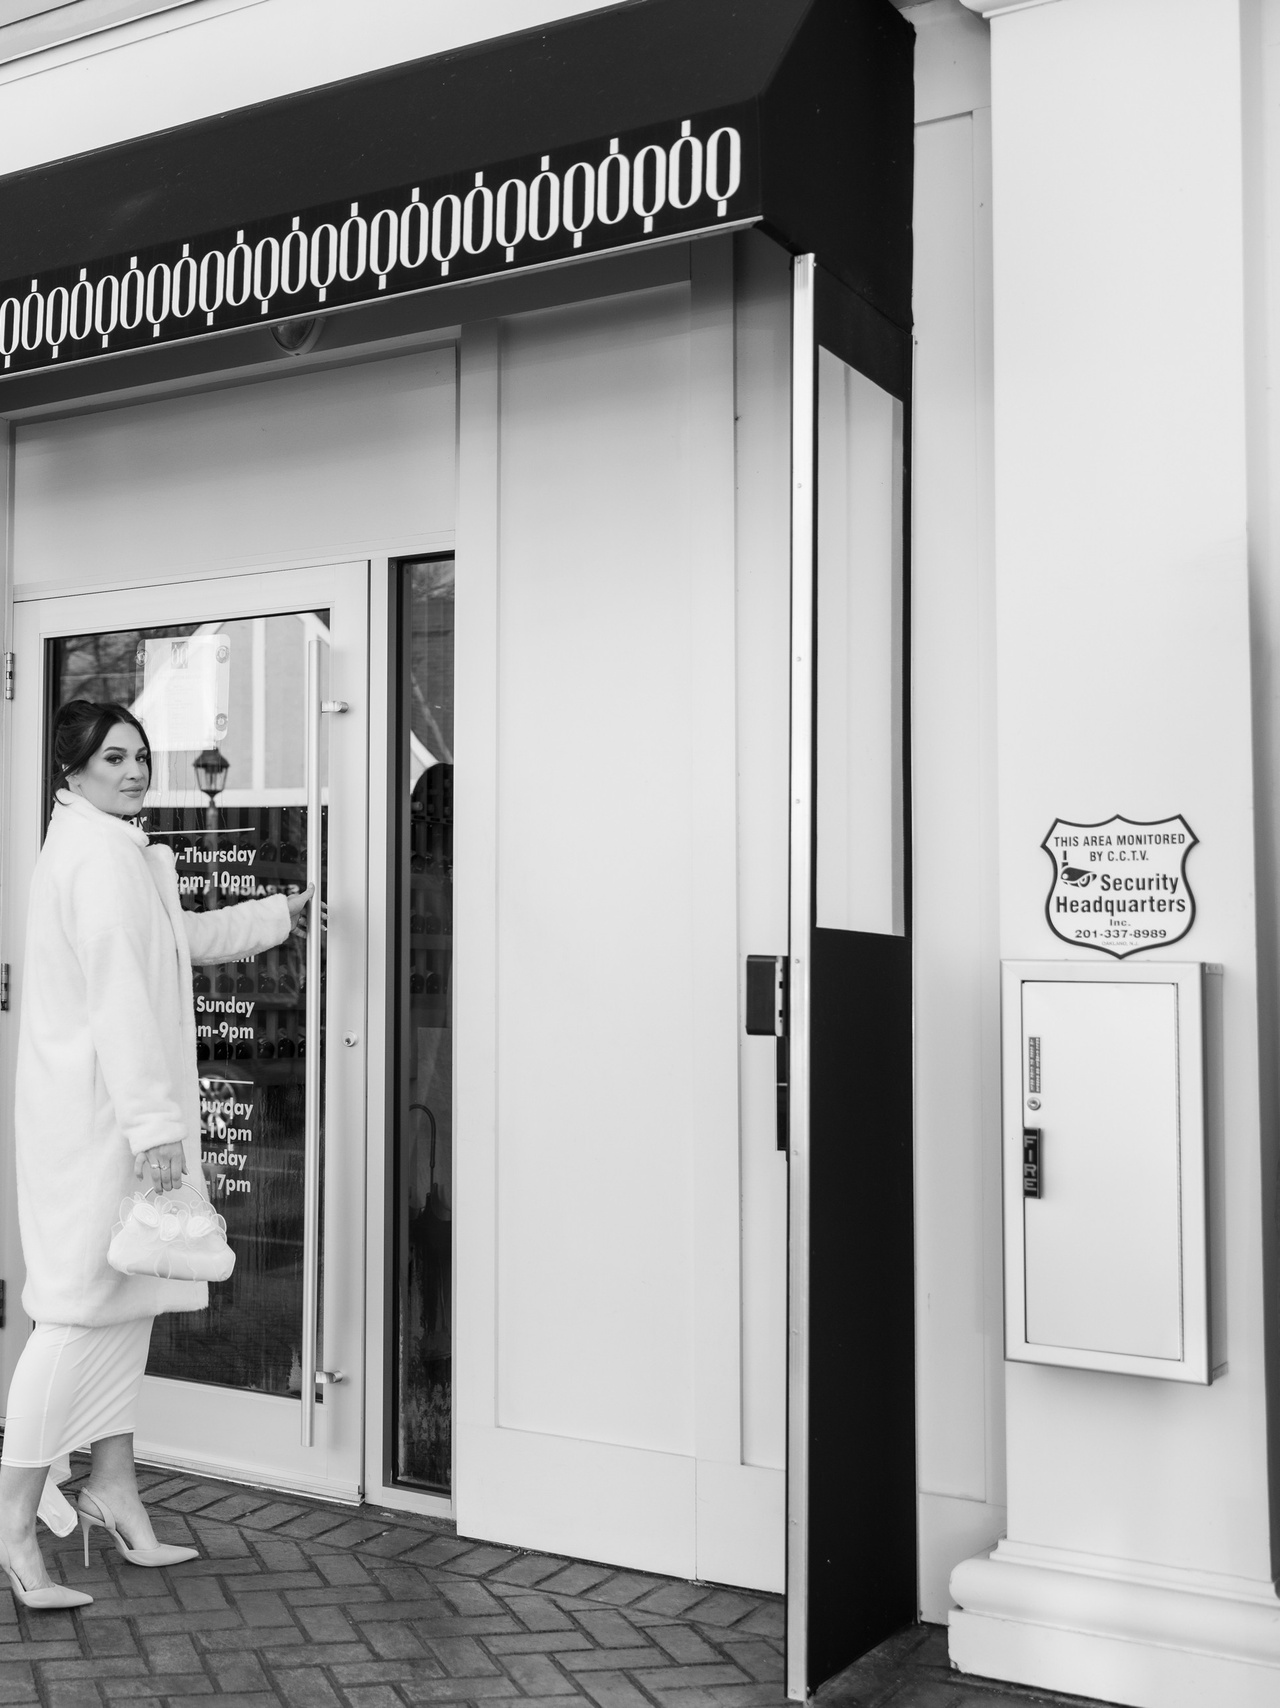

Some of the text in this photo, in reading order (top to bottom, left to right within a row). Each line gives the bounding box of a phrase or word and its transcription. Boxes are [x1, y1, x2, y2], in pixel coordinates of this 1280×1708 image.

[1054, 834, 1186, 847] THIS AREA MONITORED
[1089, 850, 1149, 862] BY C.C.T.V.
[1100, 873, 1179, 894] Security
[1056, 896, 1186, 916] Headquarters
[1075, 929, 1167, 939] 201-337-8989
[1109, 919, 1131, 927] Inc.
[196, 996, 255, 1018] Sunday
[197, 1021, 254, 1043] m-9pm
[201, 1097, 254, 1120] turday
[201, 1123, 252, 1145] -10pm
[201, 1149, 247, 1171] unday
[1024, 1135, 1037, 1191] FIRE
[217, 1174, 251, 1196] 7pm
